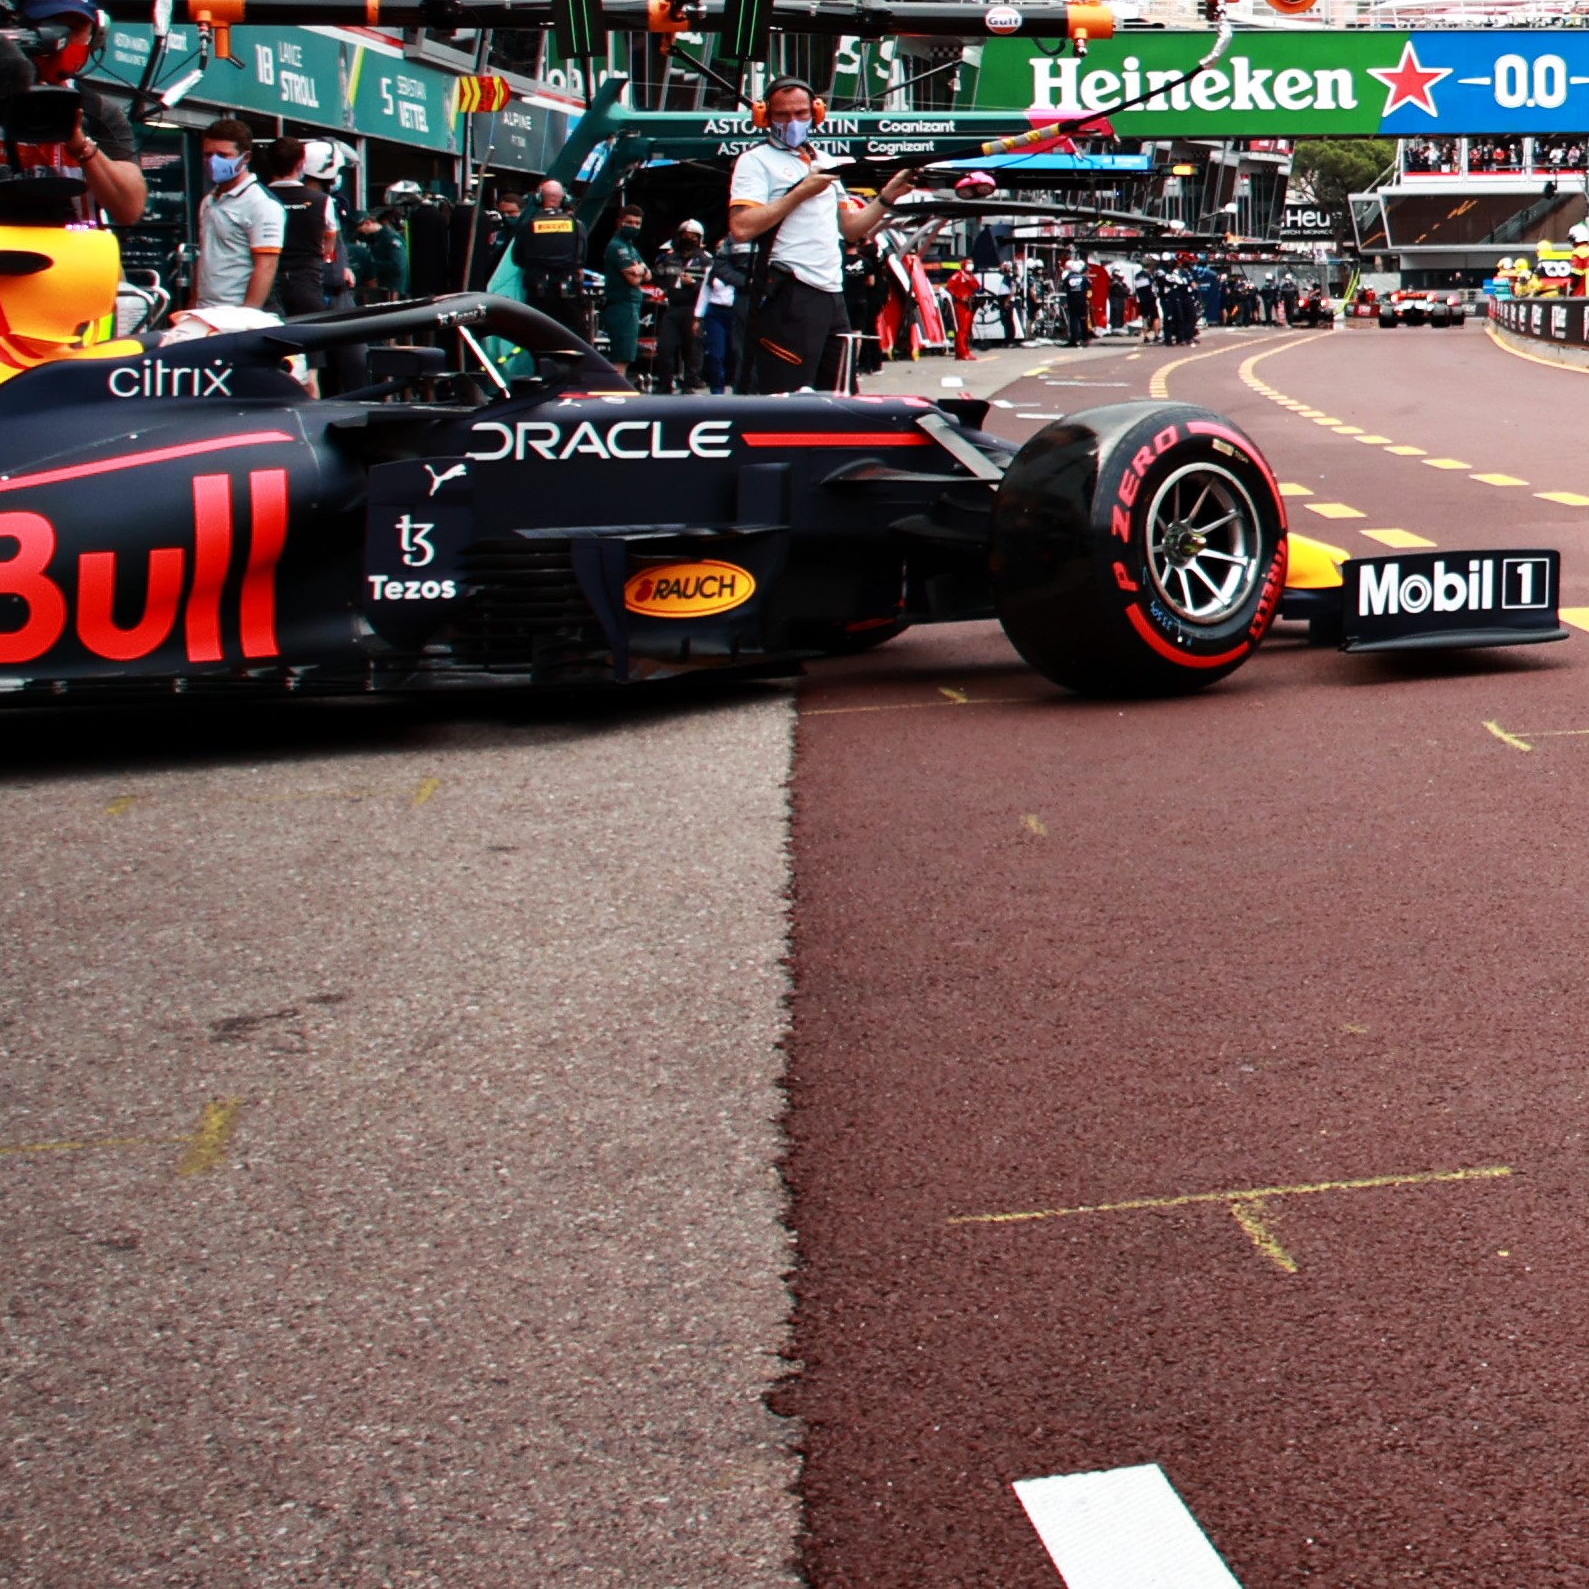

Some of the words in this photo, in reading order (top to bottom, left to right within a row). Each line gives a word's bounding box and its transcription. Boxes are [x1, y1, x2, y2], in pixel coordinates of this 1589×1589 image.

[988, 16, 1018, 26] Gulf
[278, 41, 302, 67] LANCE
[280, 70, 319, 108] STROLL
[380, 77, 394, 116] 5
[1030, 57, 1357, 111] Heineken
[398, 100, 429, 133] VETTEL
[503, 112, 532, 131] ALPINE
[704, 119, 769, 134] ASTO
[809, 119, 859, 134] RTIN
[718, 141, 757, 156] AST
[809, 140, 851, 155] RTIN
[867, 140, 934, 156] Cognizant
[109, 358, 233, 400] citrix
[465, 421, 732, 461] ORACLE
[1111, 425, 1180, 543] ZERO
[368, 575, 457, 601] Tezos
[652, 574, 736, 601] RAUCH
[1112, 561, 1139, 592] P
[1359, 559, 1494, 616] Mobil
